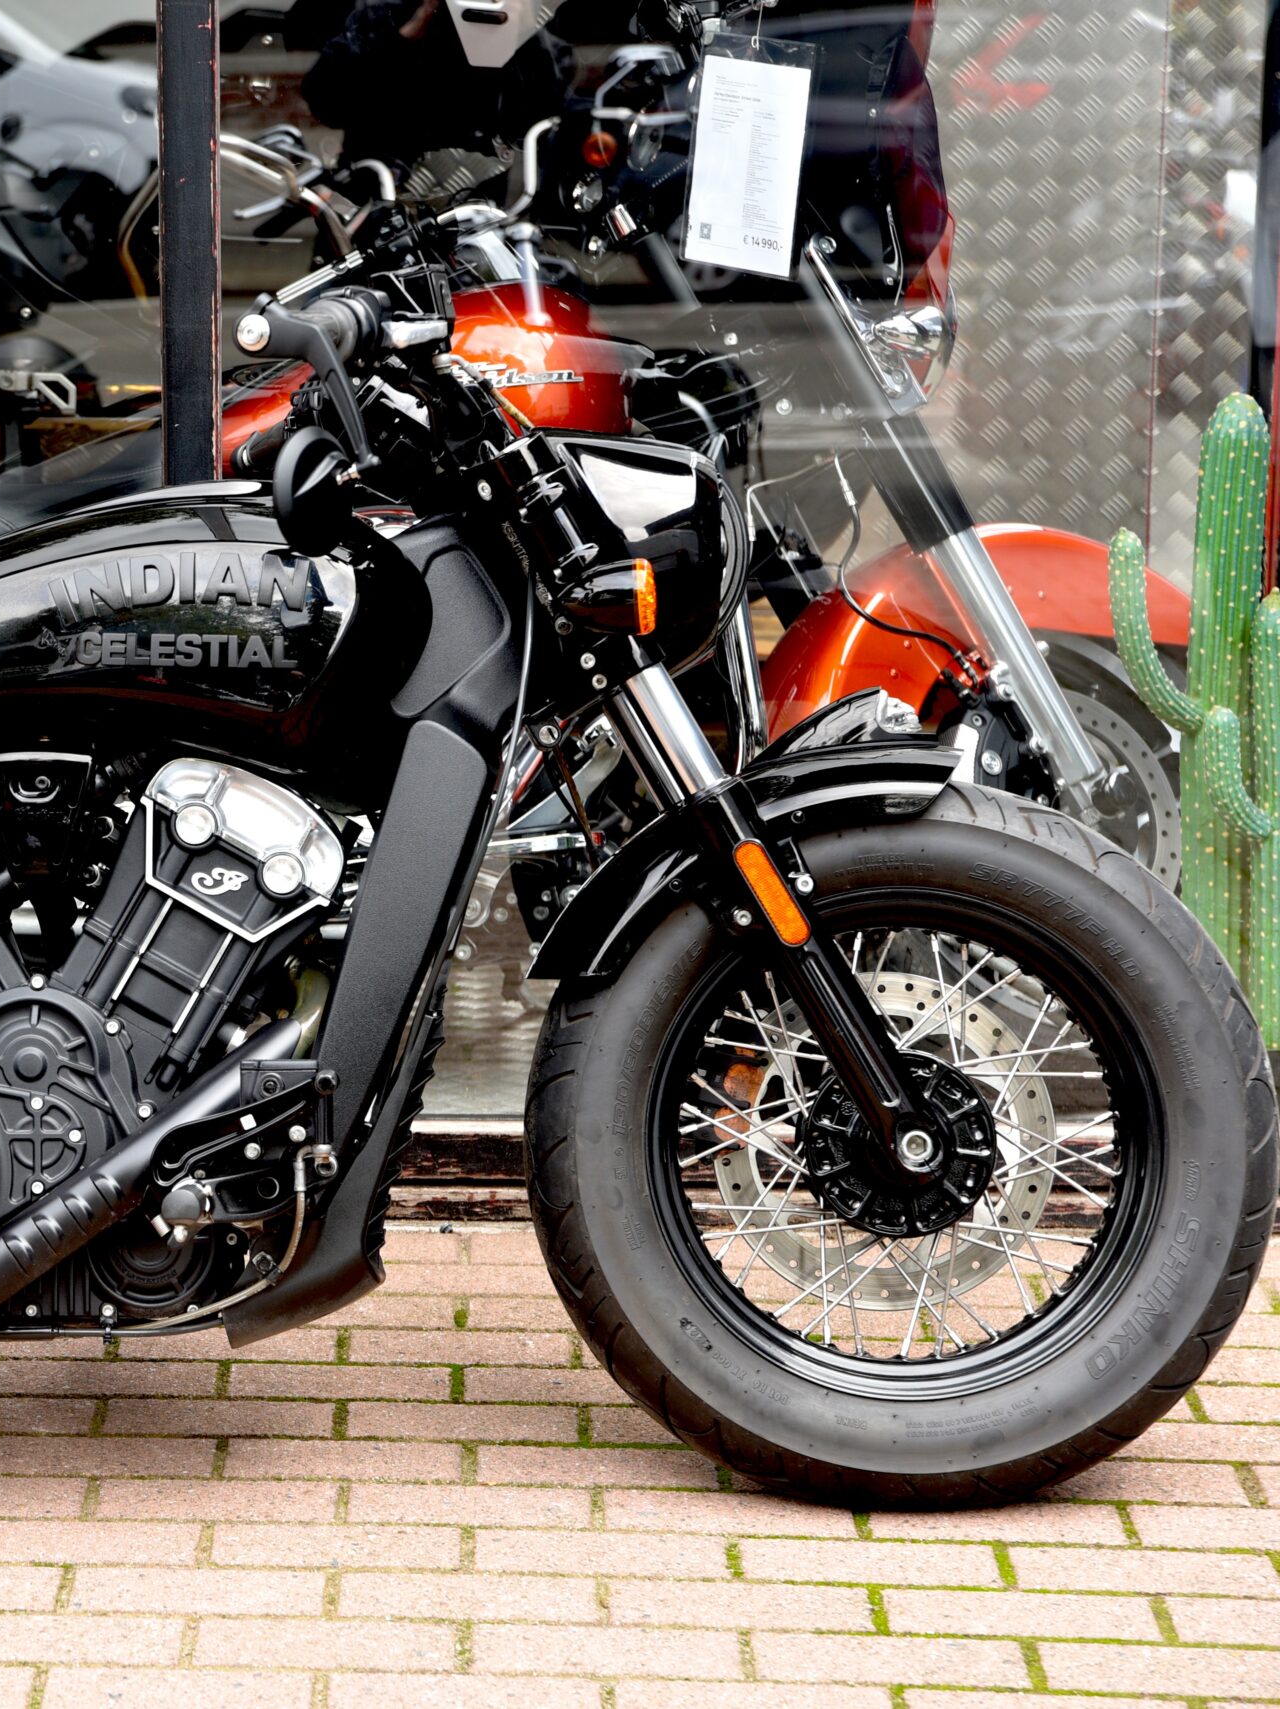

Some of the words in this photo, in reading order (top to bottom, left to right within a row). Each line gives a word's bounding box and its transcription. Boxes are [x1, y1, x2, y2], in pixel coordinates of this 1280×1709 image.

[48, 551, 313, 629] INDIAN
[76, 632, 298, 669] CELESTIAL
[1086, 1212, 1201, 1380] SHINKO
